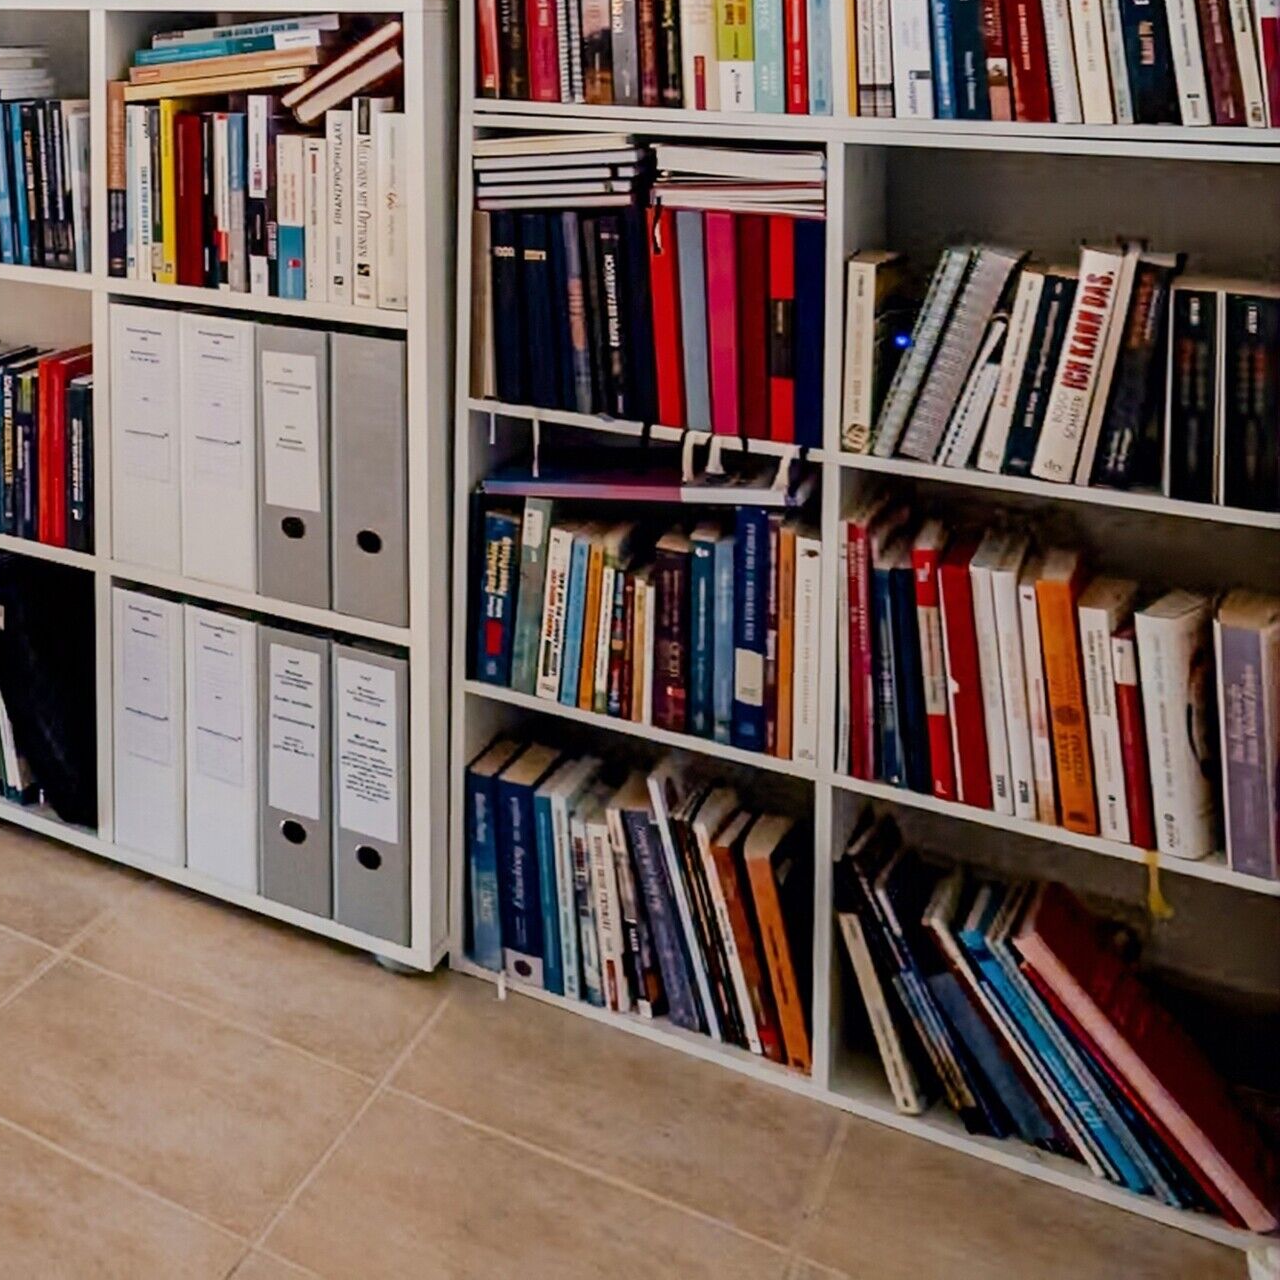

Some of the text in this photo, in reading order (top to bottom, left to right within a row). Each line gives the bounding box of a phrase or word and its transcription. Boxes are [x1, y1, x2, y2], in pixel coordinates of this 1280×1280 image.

[1059, 270, 1114, 391] ICH KANN DAS.
